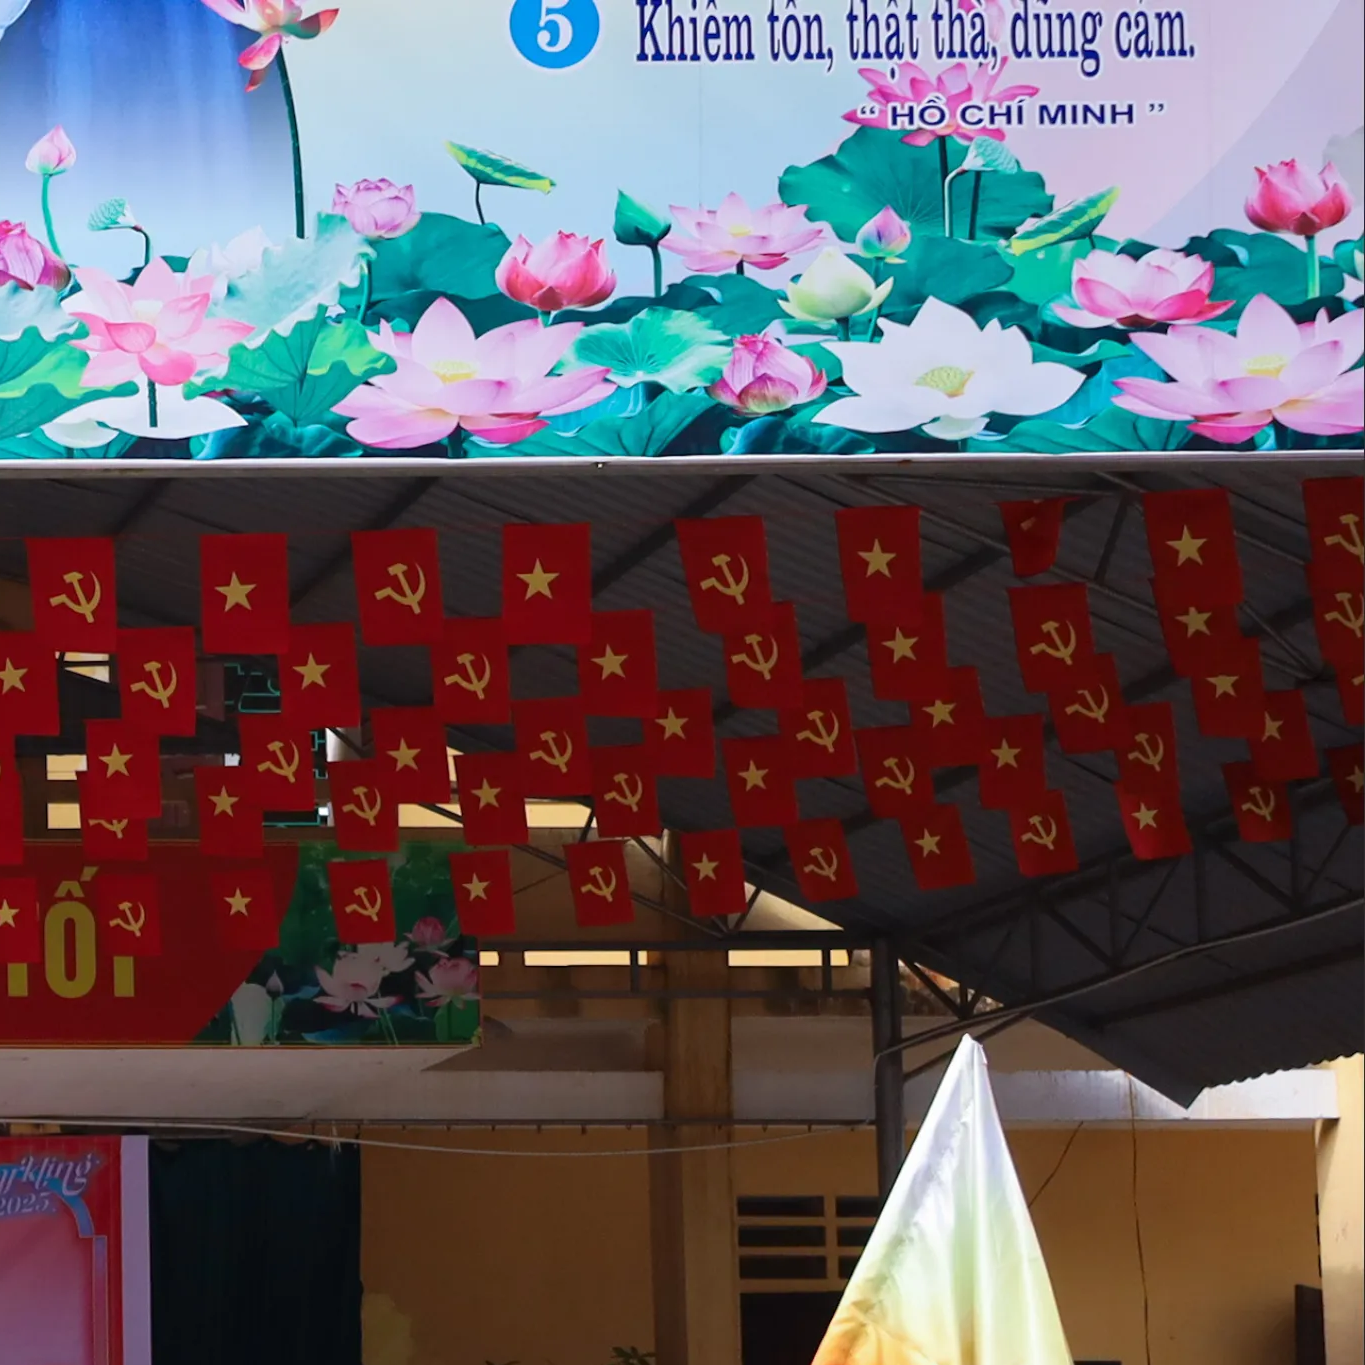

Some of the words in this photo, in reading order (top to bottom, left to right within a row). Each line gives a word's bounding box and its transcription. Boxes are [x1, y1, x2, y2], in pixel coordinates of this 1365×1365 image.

[537, 0, 573, 52] 5
[636, 0, 755, 62] Khiêm
[846, 0, 919, 80] thật
[1010, 0, 1103, 77] dũng
[889, 95, 947, 127] HỒ
[959, 94, 1032, 126] CHÍ
[1038, 103, 1134, 125] MINH
